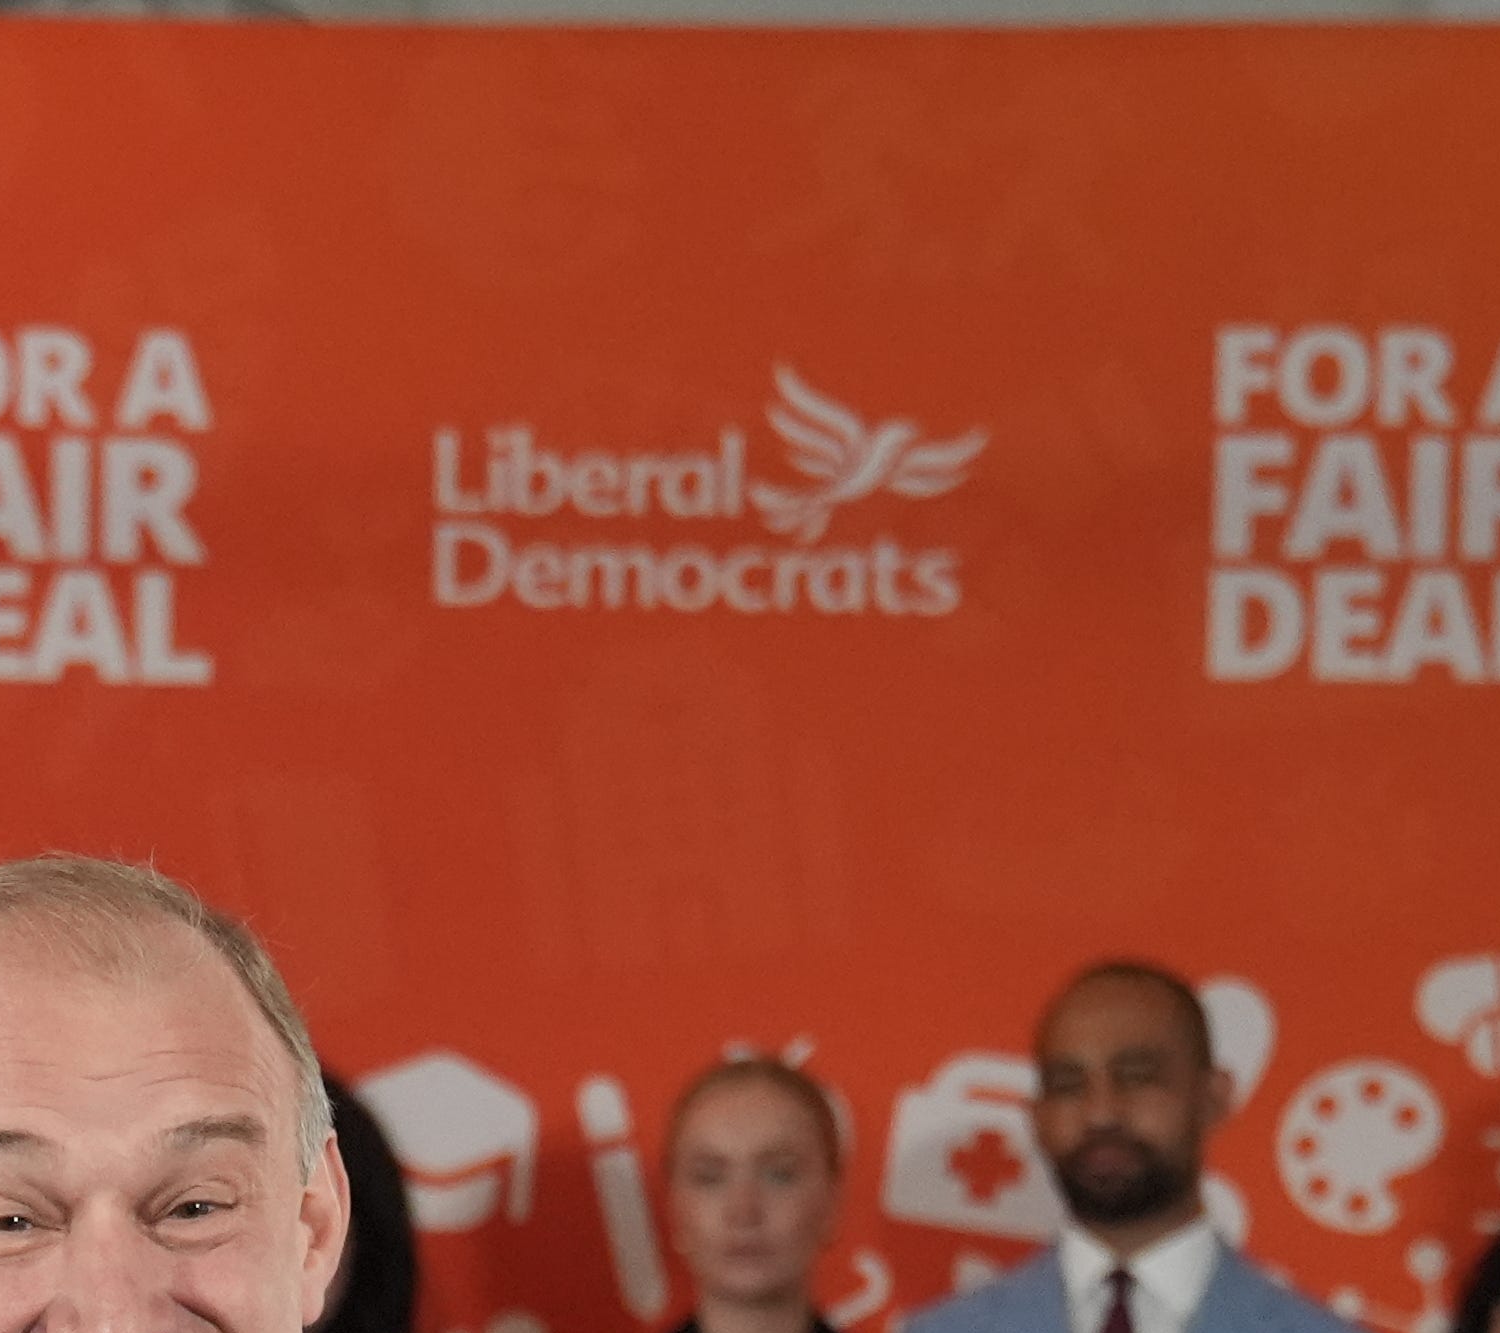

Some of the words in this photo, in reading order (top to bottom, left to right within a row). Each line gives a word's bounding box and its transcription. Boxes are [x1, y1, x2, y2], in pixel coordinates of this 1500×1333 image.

[115, 328, 212, 431] A
[1214, 324, 1457, 427] FOR
[434, 428, 744, 520] Liberal
[435, 527, 961, 615] Democrats
